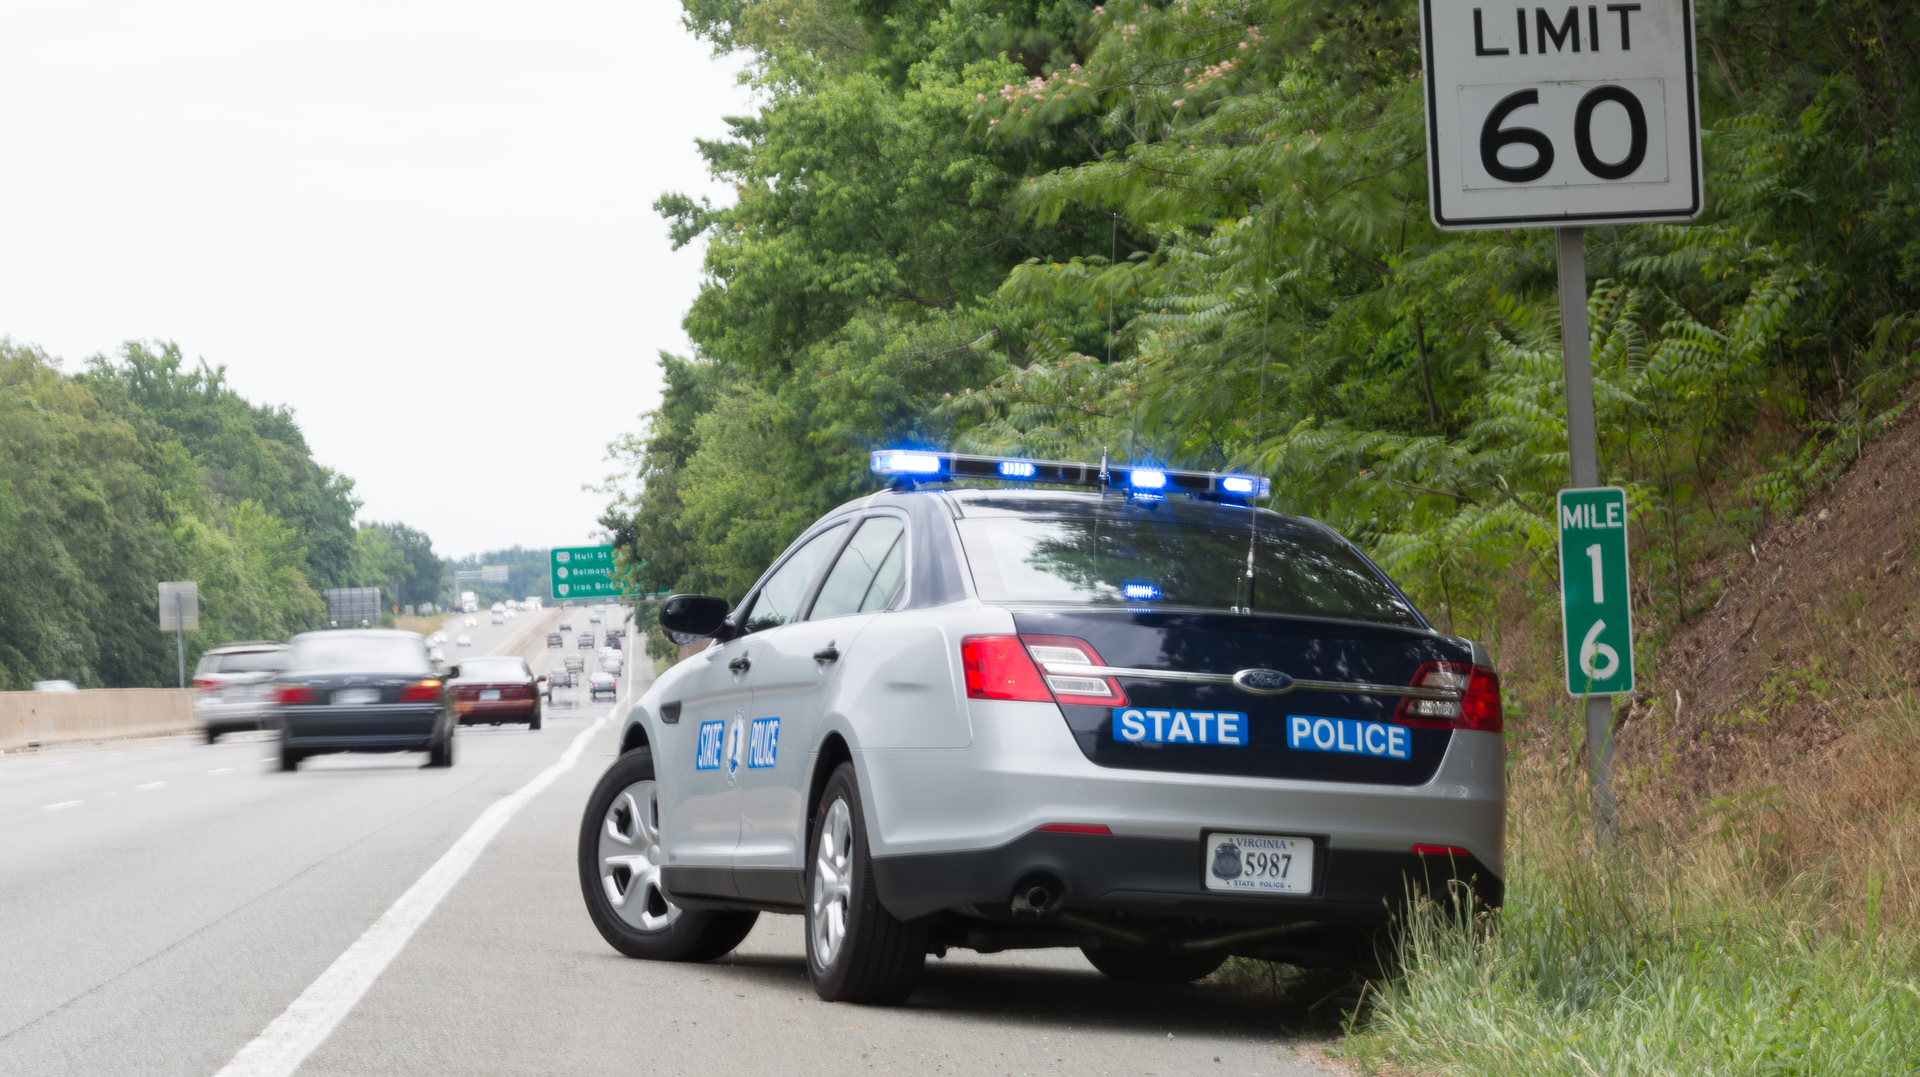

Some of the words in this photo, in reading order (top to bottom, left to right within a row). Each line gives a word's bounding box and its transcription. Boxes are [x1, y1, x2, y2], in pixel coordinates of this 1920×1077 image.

[1473, 3, 1641, 56] LIMIT
[1480, 84, 1648, 182] 60
[1562, 502, 1622, 529] MILE
[574, 552, 593, 560] Hull
[597, 551, 607, 559] St
[572, 567, 610, 575] Belmont
[1586, 543, 1604, 604] 1
[560, 585, 567, 593] 10
[1579, 618, 1620, 681] 6
[1249, 671, 1282, 686] Ford
[698, 722, 723, 767] STATE
[748, 719, 779, 766] POLICE
[1121, 709, 1241, 744] STATE
[1292, 716, 1406, 758] POLICE
[1235, 837, 1288, 850] VIRGINIA
[1244, 852, 1292, 879] 5987
[1259, 881, 1285, 889] POLICE
